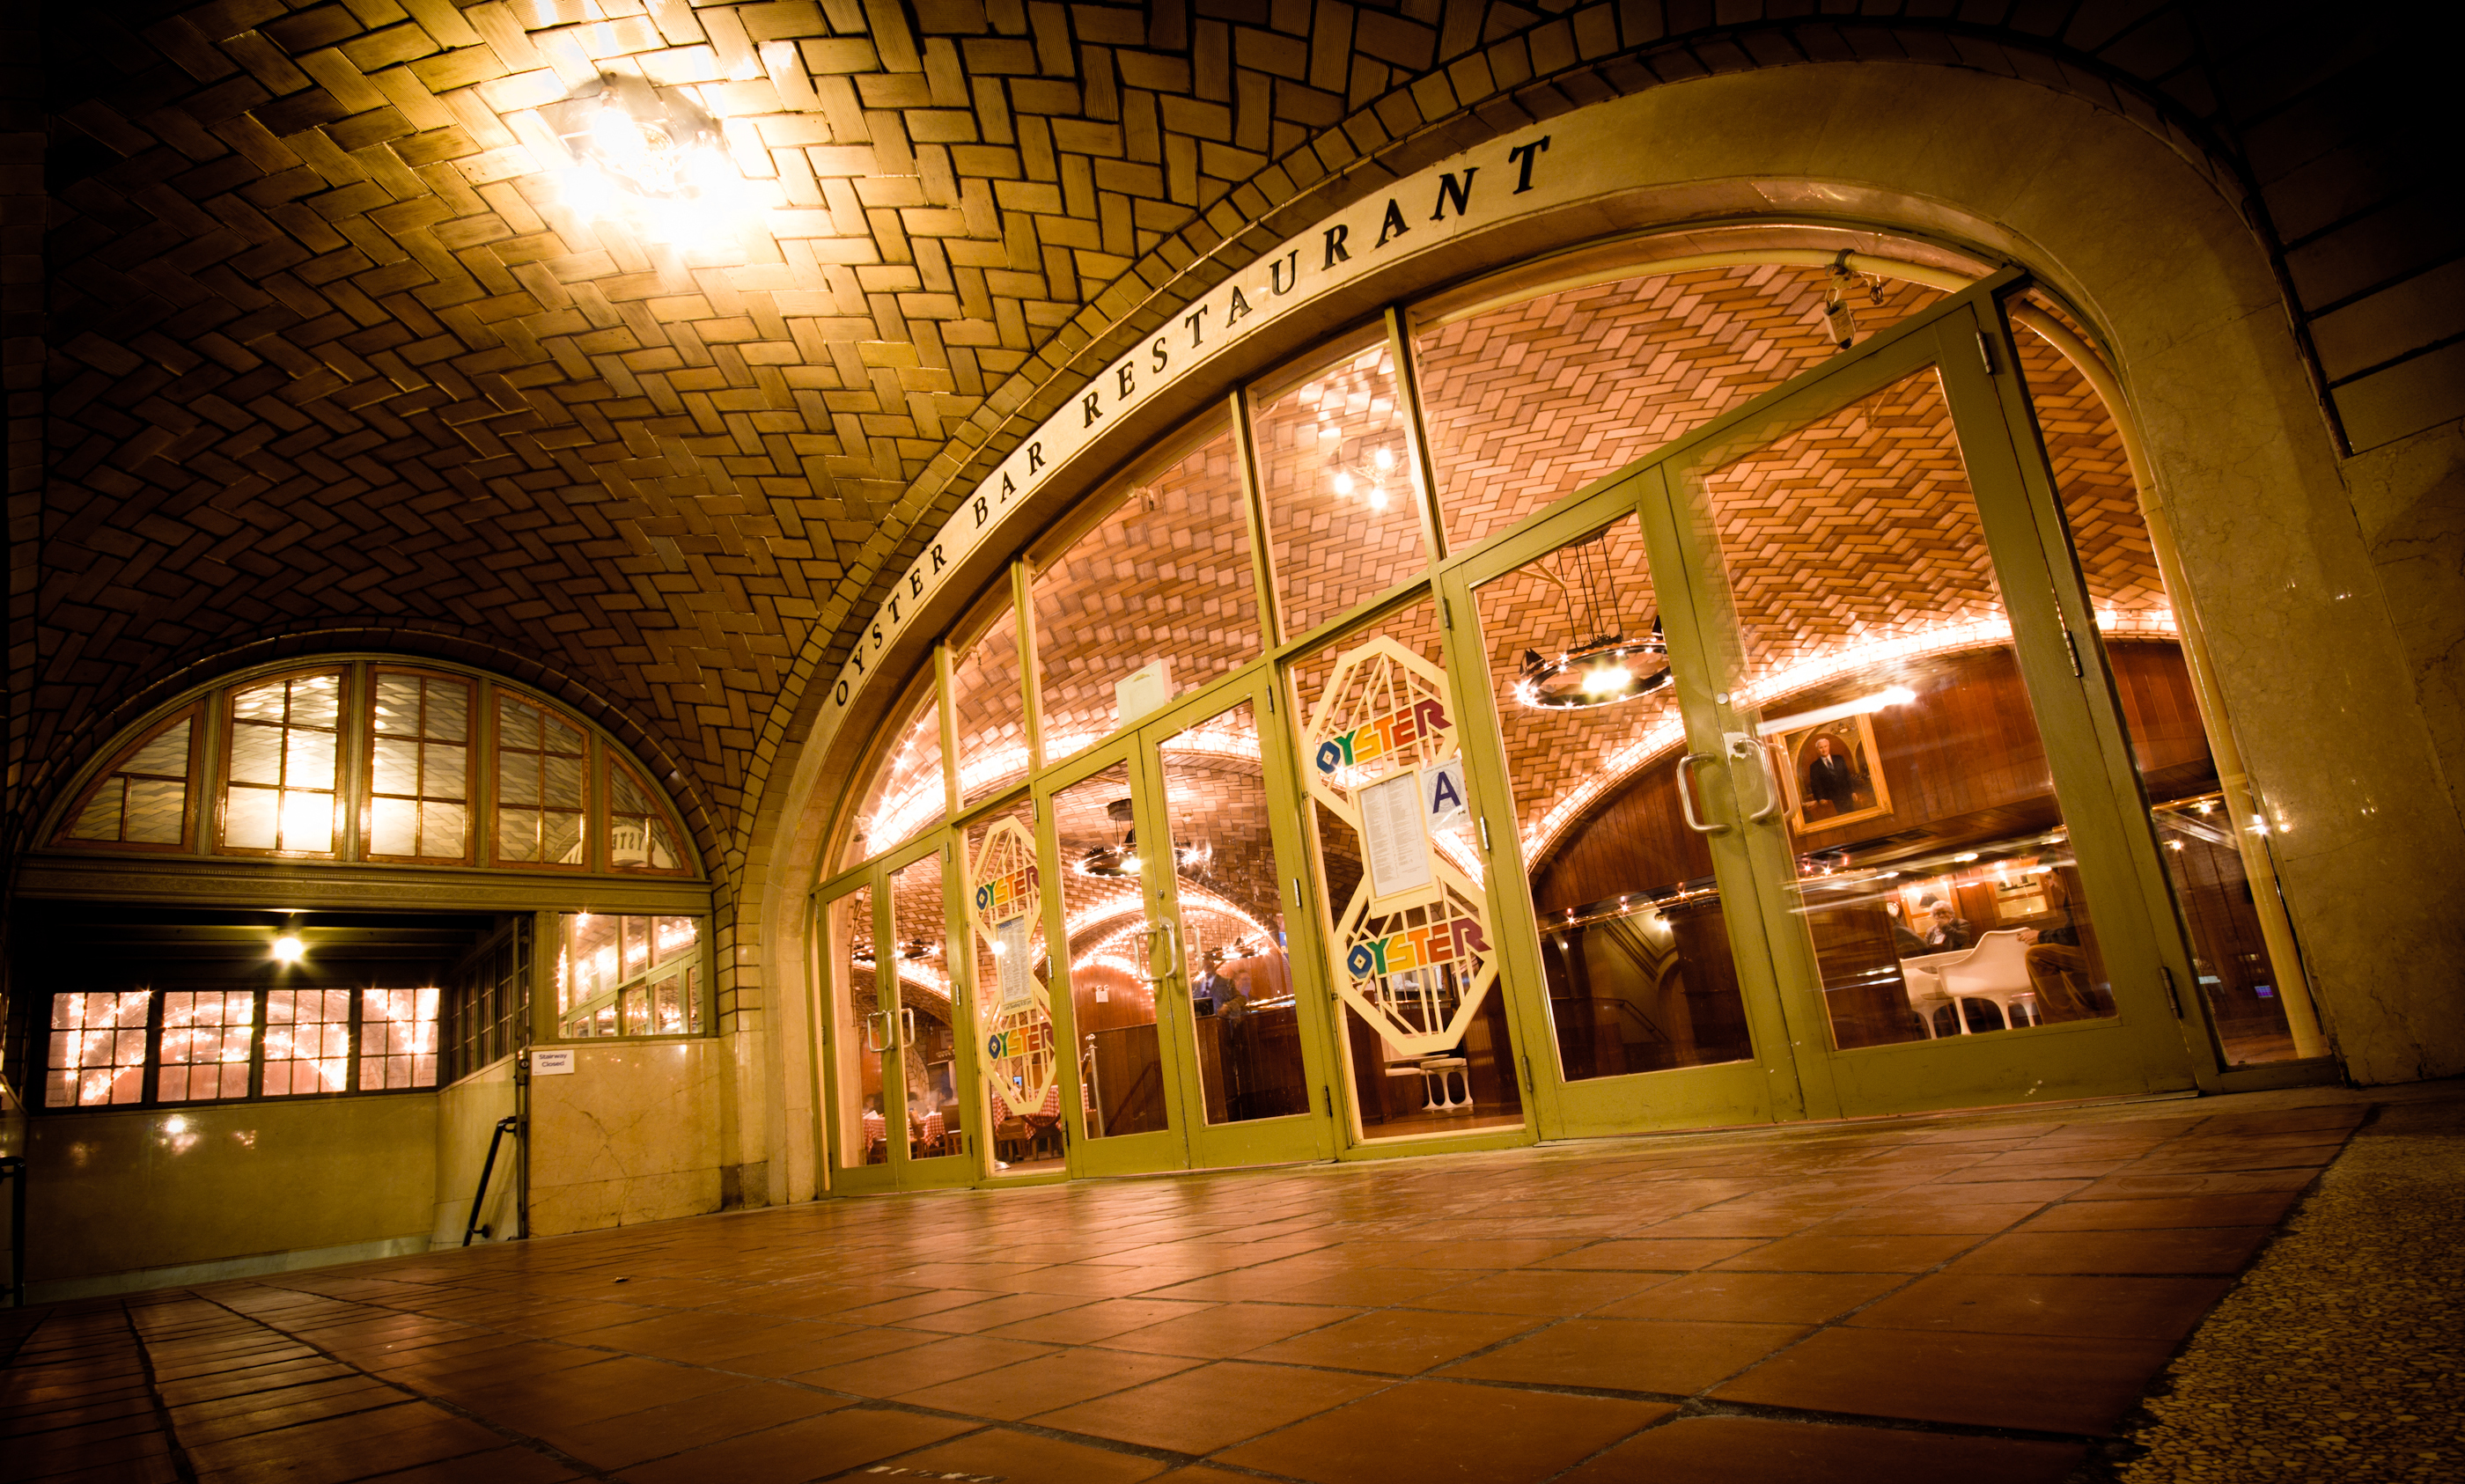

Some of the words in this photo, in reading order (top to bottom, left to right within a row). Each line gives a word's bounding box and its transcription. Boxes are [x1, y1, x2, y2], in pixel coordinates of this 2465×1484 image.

[835, 543, 947, 707] OYSTER
[973, 441, 1047, 529] BAR
[1082, 135, 1550, 429] RESTAURANT
[1316, 698, 1453, 775] OYSTER
[1432, 771, 1461, 814] A
[976, 864, 1040, 910] OYSTER
[1347, 917, 1492, 979] OYSTER
[988, 1021, 1054, 1059] OYSTER
